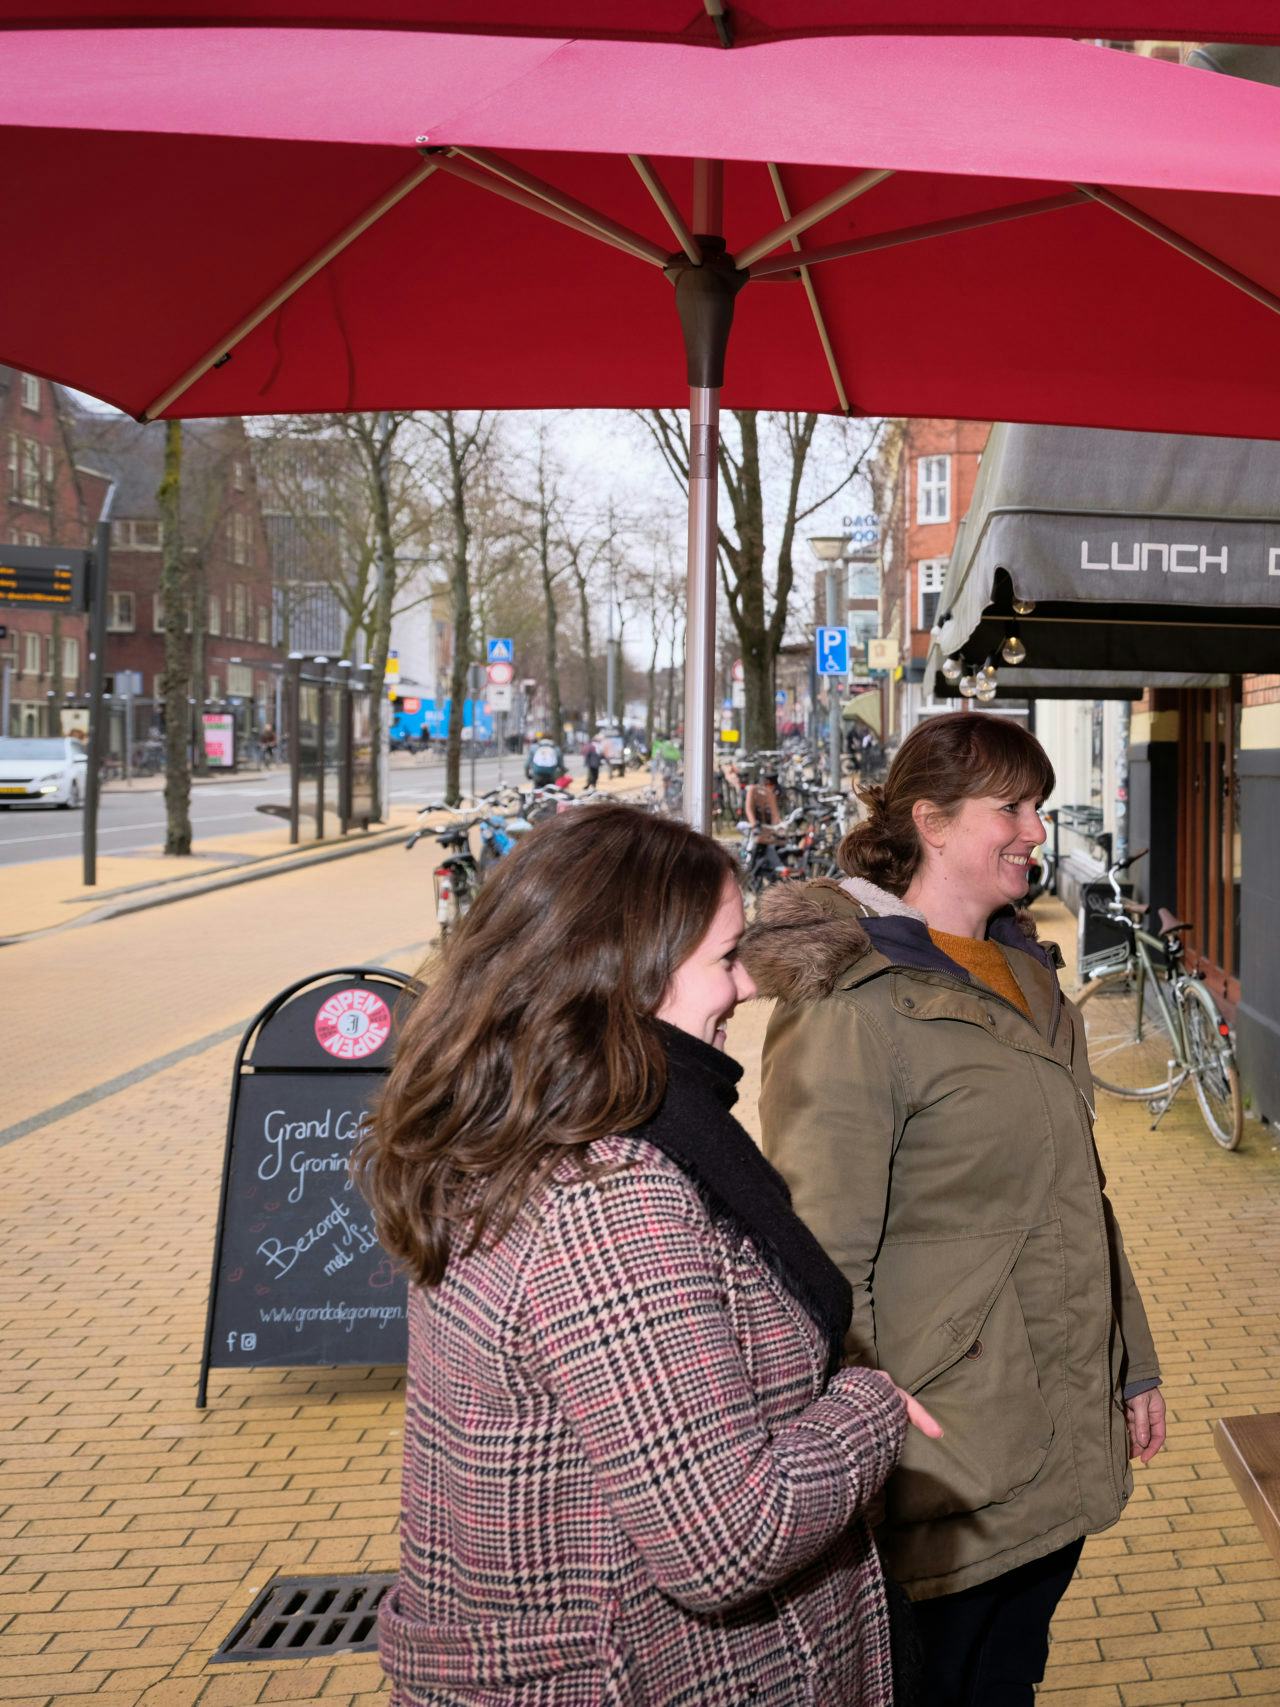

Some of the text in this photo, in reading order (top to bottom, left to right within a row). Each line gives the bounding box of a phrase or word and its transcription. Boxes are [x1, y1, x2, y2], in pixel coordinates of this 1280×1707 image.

[1081, 541, 1228, 575] LUNCH
[823, 629, 842, 656] P
[318, 990, 383, 1026] JOPEN
[323, 1022, 389, 1058] JOPEN
[257, 1107, 332, 1181] Grand
[255, 1196, 351, 1281] Bezorgt
[322, 1241, 355, 1278] met
